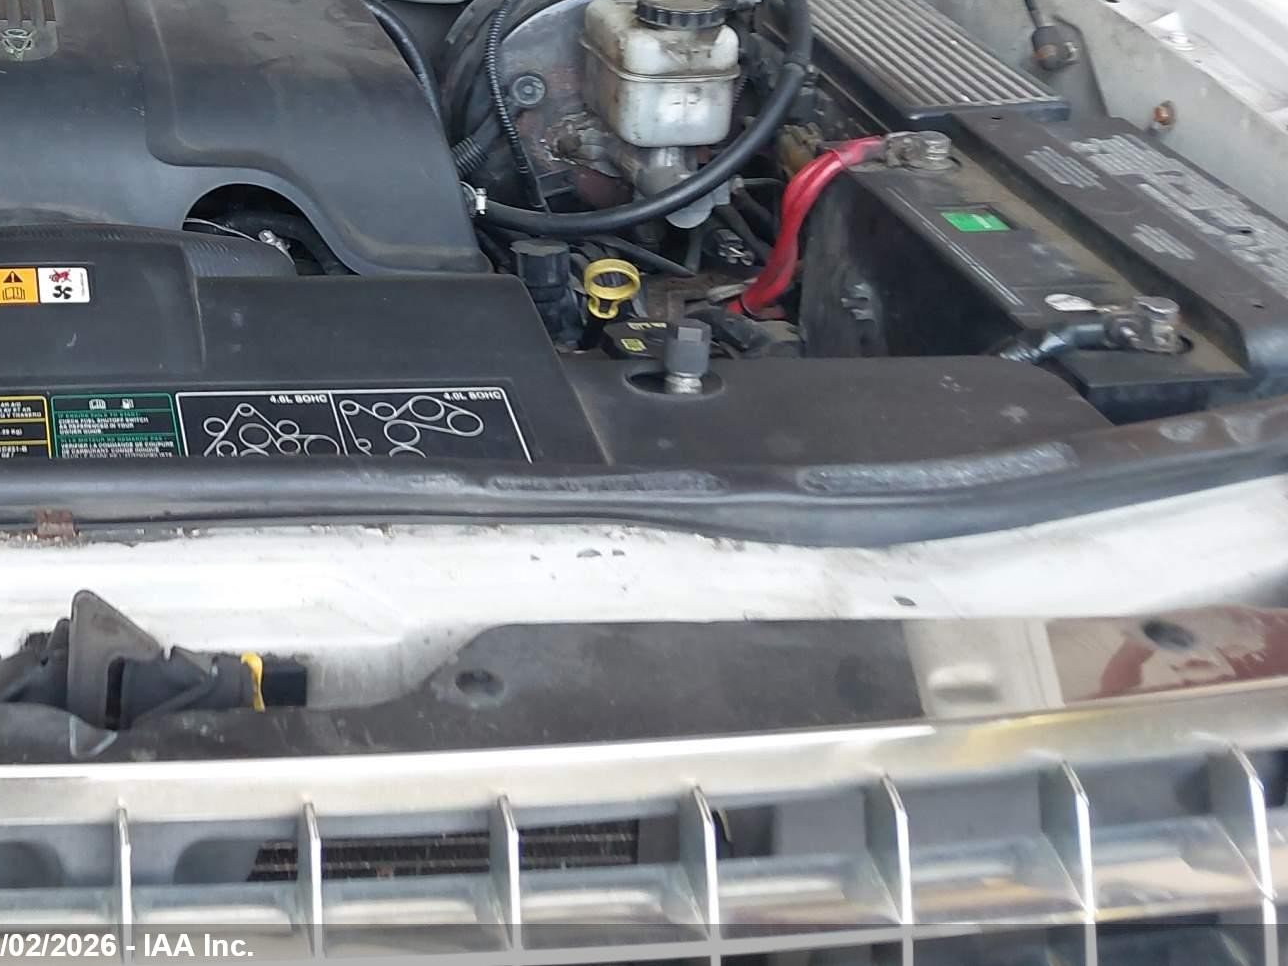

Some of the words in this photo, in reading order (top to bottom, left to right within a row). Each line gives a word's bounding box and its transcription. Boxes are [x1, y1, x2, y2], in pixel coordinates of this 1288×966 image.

[294, 394, 328, 404] SOHC
[443, 392, 468, 401] 4.0L
[468, 391, 502, 401] SOHC
